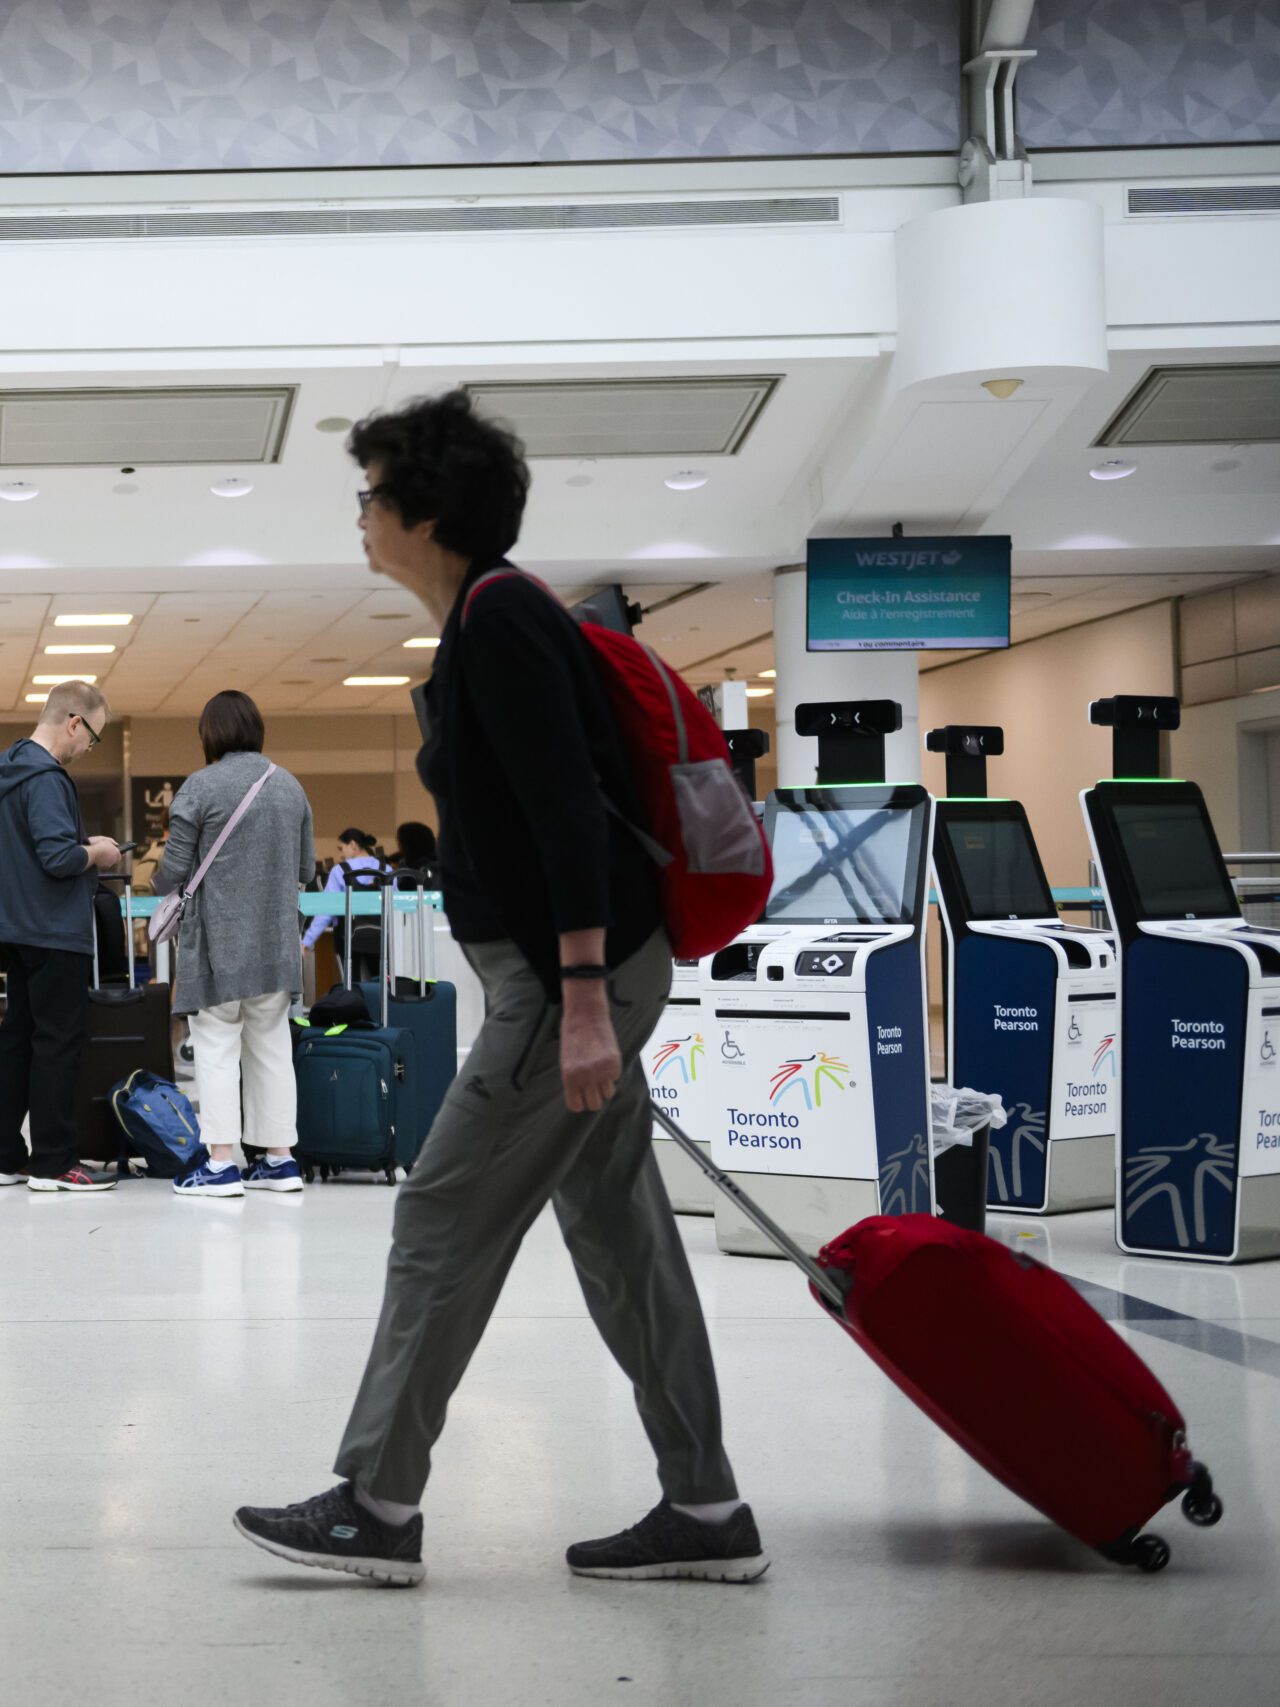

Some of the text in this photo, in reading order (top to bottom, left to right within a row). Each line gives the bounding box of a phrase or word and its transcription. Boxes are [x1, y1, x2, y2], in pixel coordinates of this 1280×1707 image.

[856, 551, 941, 571] WESTJET
[836, 589, 981, 604] Check-In Assistance
[842, 608, 975, 621] Aide à l'enregistrement
[993, 1005, 1038, 1018] Toronto
[993, 1018, 1038, 1031] Pearson
[1171, 1019, 1225, 1033] Toronto
[877, 1026, 902, 1039] Toronto
[877, 1041, 902, 1055] Pearson
[1172, 1035, 1226, 1050] Pearson
[1066, 1082, 1107, 1098] Toronto
[1065, 1102, 1107, 1117] Pearson
[727, 1108, 799, 1128] Toronto
[727, 1130, 802, 1150] Pearson
